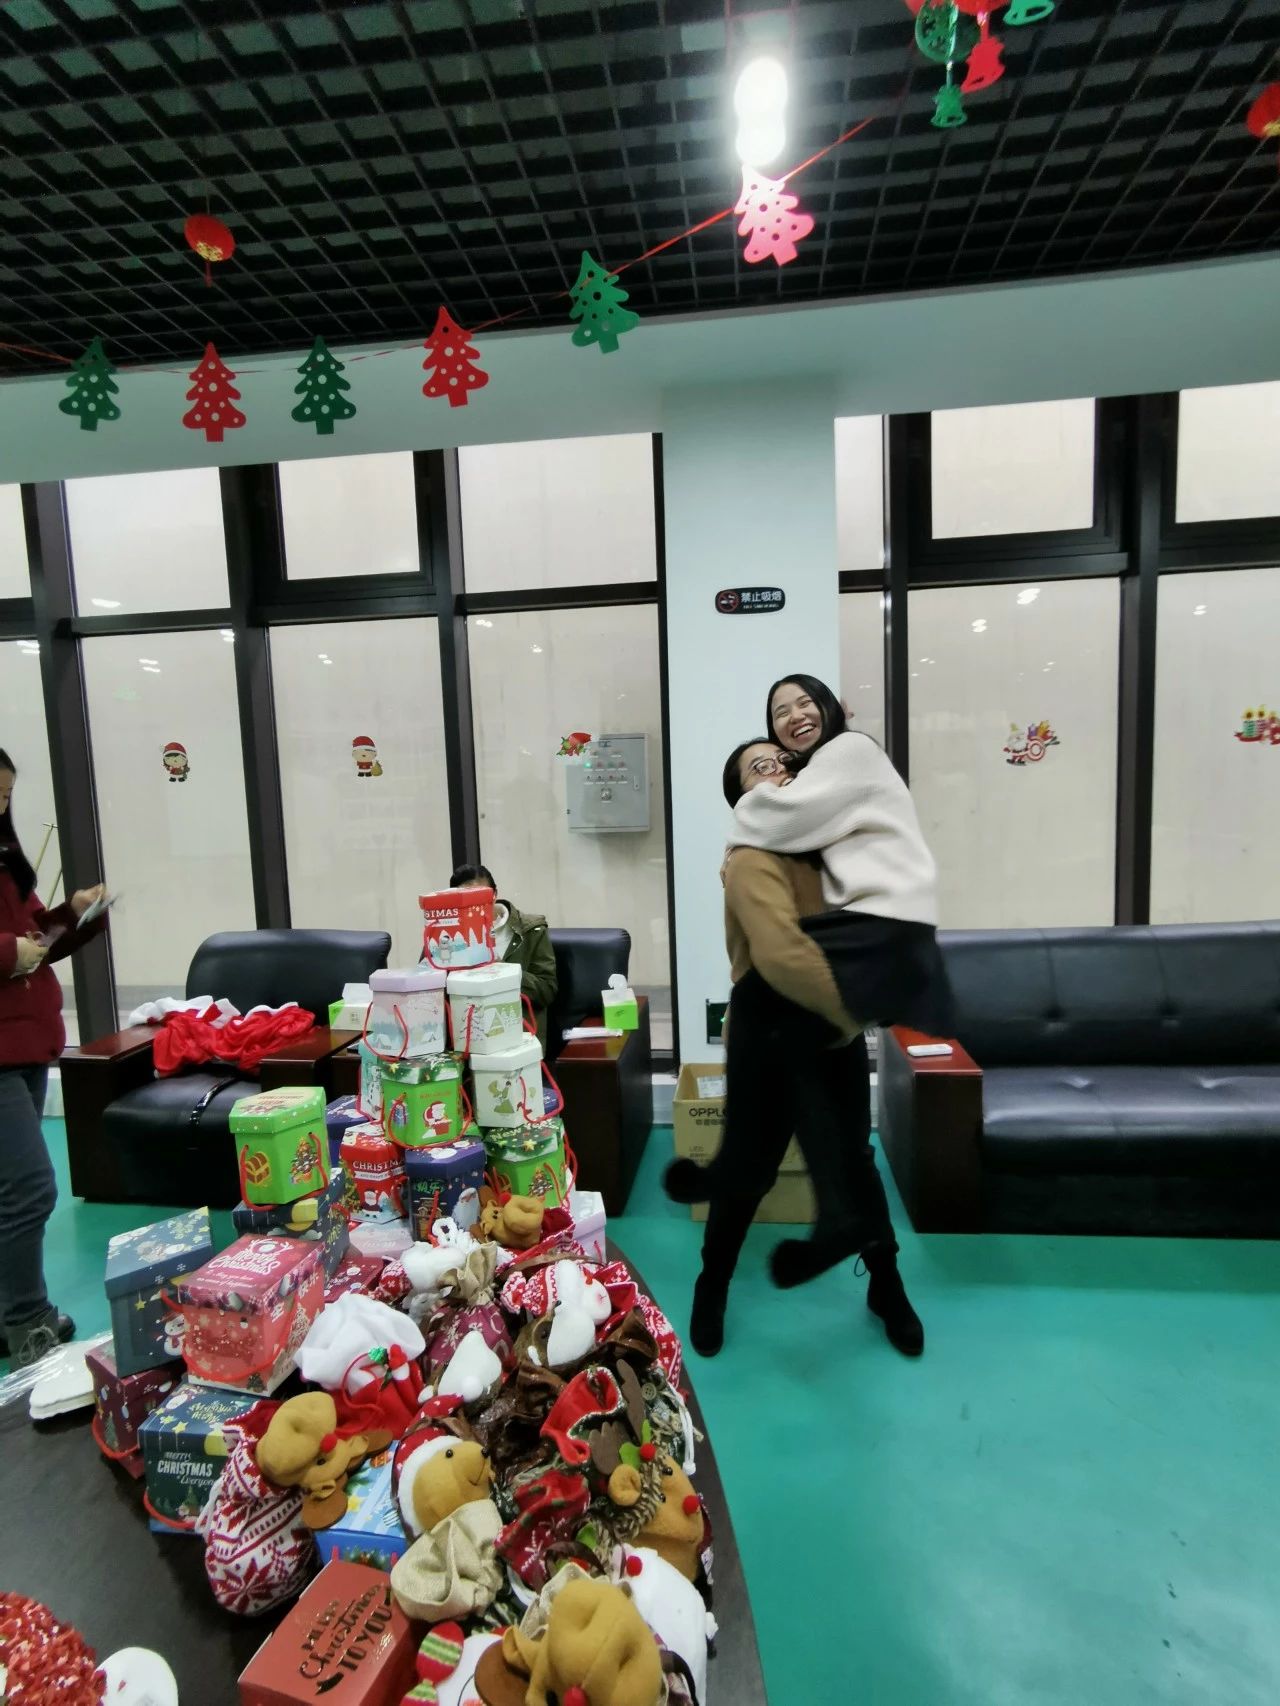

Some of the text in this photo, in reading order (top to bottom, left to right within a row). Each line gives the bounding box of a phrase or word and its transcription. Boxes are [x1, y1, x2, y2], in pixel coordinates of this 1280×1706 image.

[741, 590, 782, 603] 禁止吸烟
[157, 1460, 213, 1477] CHRISTMAS
[336, 1606, 393, 1671] TO YOU
